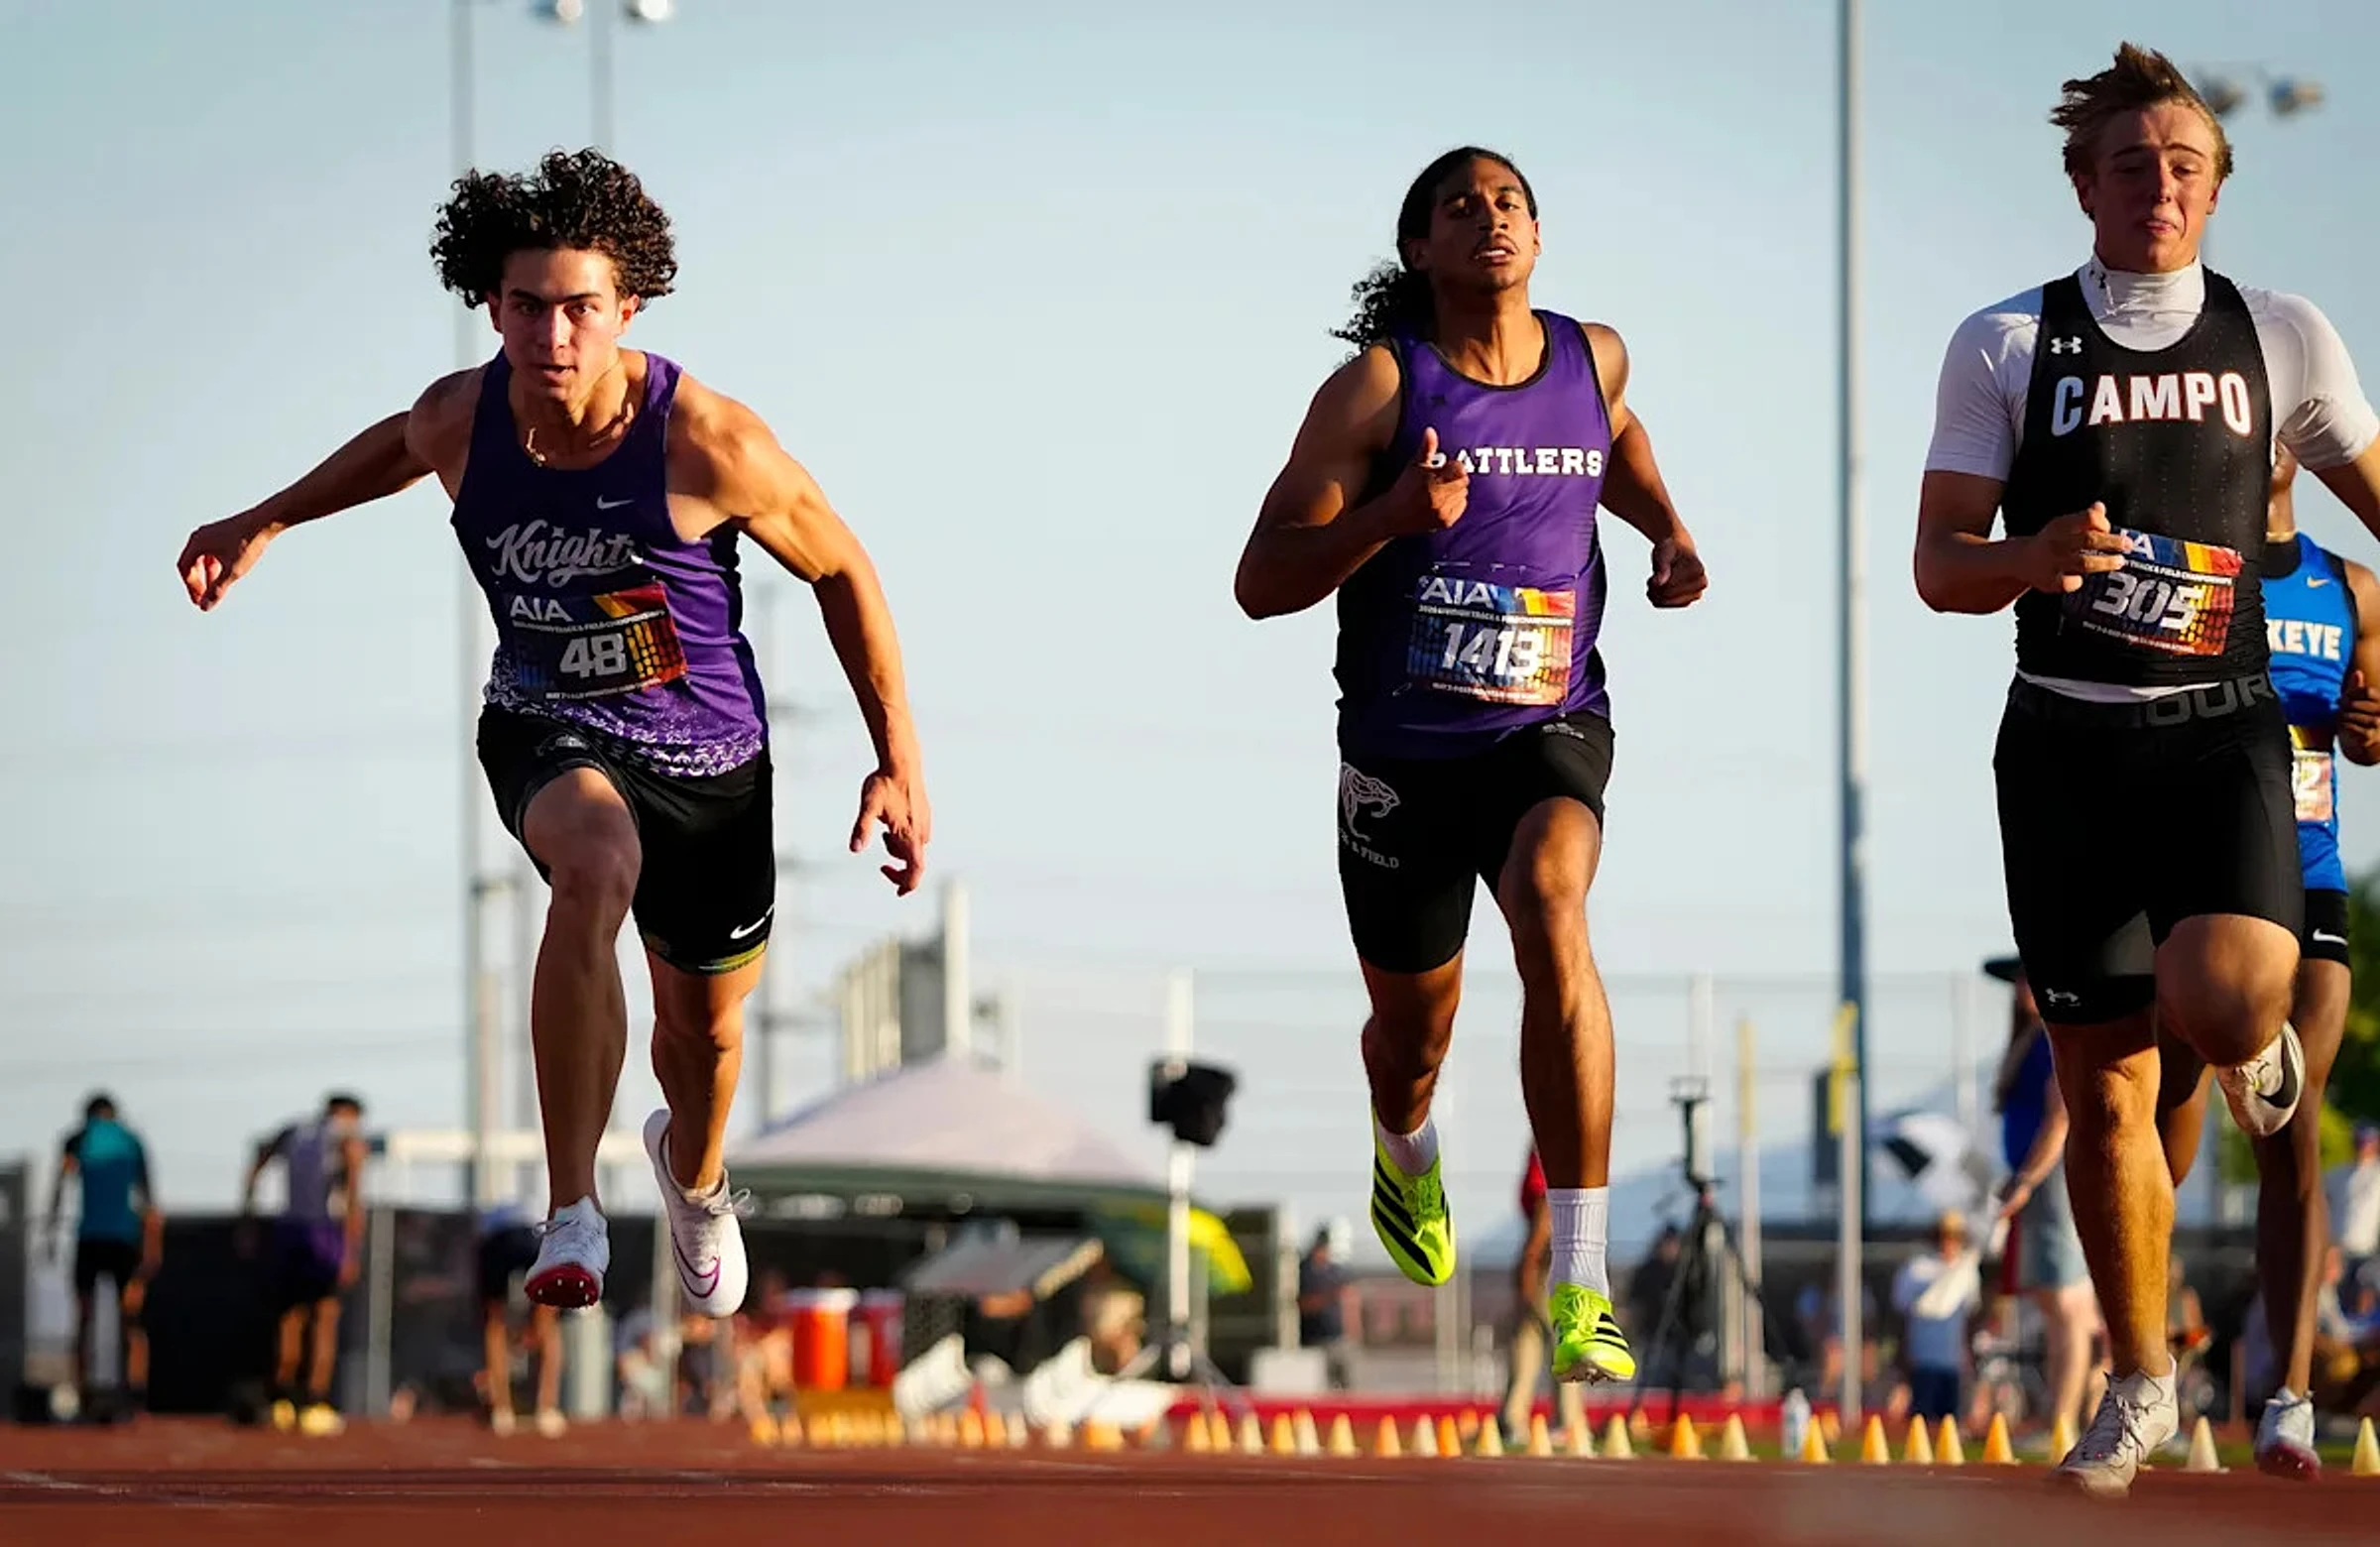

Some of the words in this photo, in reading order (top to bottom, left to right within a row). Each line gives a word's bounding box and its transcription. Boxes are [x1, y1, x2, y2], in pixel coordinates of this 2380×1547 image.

[2050, 371, 2254, 437] CAMPO
[510, 595, 574, 622] AIA
[1420, 576, 1495, 610] AIA
[2092, 570, 2205, 631] 305
[559, 633, 627, 678] 48
[2265, 618, 2342, 661] KEYE
